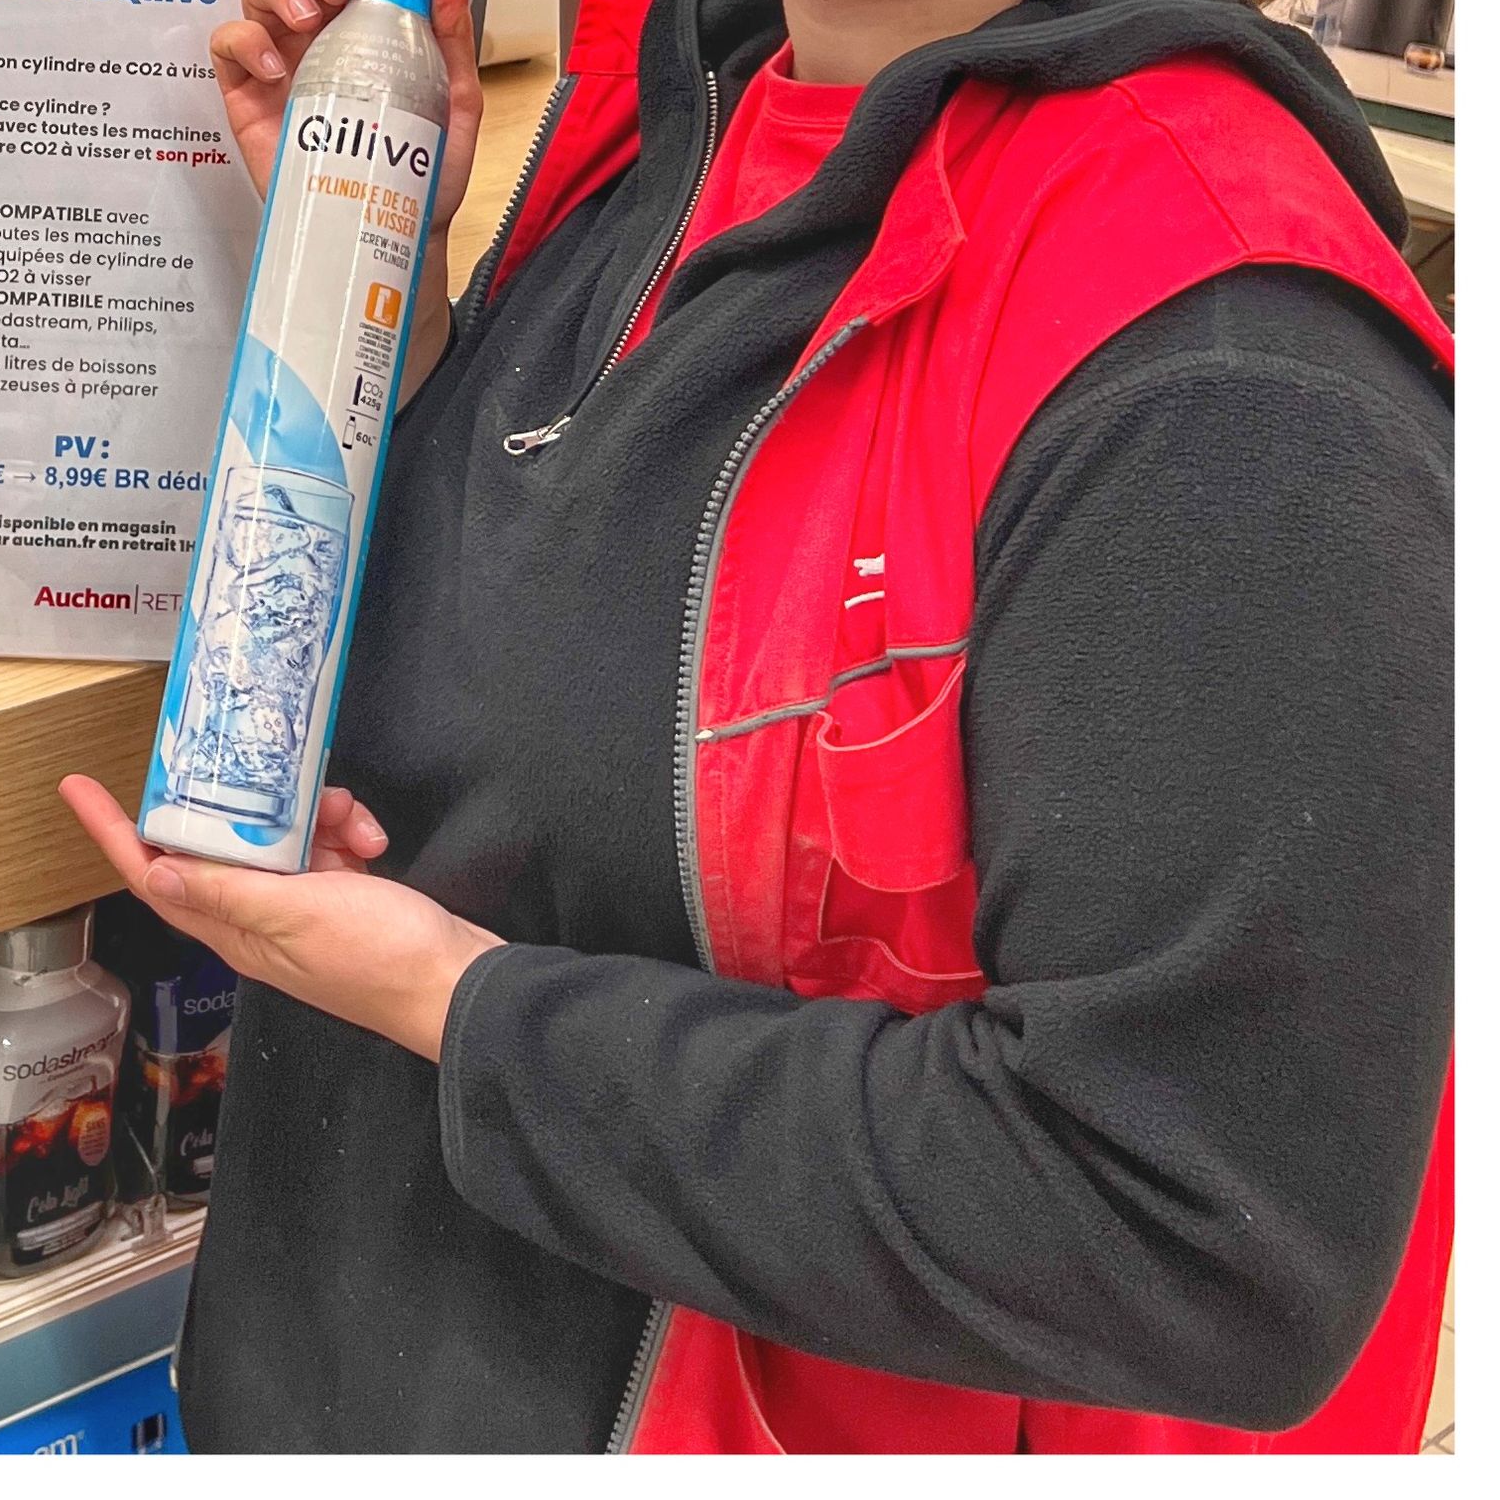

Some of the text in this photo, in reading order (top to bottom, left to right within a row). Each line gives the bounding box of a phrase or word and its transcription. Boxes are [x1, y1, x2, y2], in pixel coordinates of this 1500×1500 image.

[21, 54, 96, 77] cylindre
[126, 60, 162, 77] CO2
[181, 63, 216, 80] viss
[24, 96, 97, 119] cylindre
[41, 121, 98, 137] toutes
[133, 124, 221, 142] machines
[20, 141, 58, 155] CO2
[76, 142, 130, 159] visser
[192, 147, 231, 167] prix.
[298, 115, 429, 177] Qilive
[107, 213, 149, 224] avec
[377, 208, 416, 240] VISSER
[74, 229, 162, 247] machines
[96, 249, 167, 272] cylindre
[373, 249, 409, 271] CYLINDER
[40, 269, 91, 287] visser
[107, 296, 195, 313] machines
[97, 316, 158, 335] Philips,
[4, 356, 47, 372] litres
[79, 358, 157, 376] boissons
[81, 378, 159, 399] préparer
[360, 395, 381, 411] 425g
[44, 466, 107, 489] 8,99€
[115, 469, 149, 489] BR
[101, 520, 176, 537] magasin
[12, 533, 96, 549] auchan.fr
[122, 537, 177, 551] retrait
[179, 540, 196, 552] 1H
[34, 586, 183, 612] Auchan RET
[3, 1031, 118, 1082] sodastream
